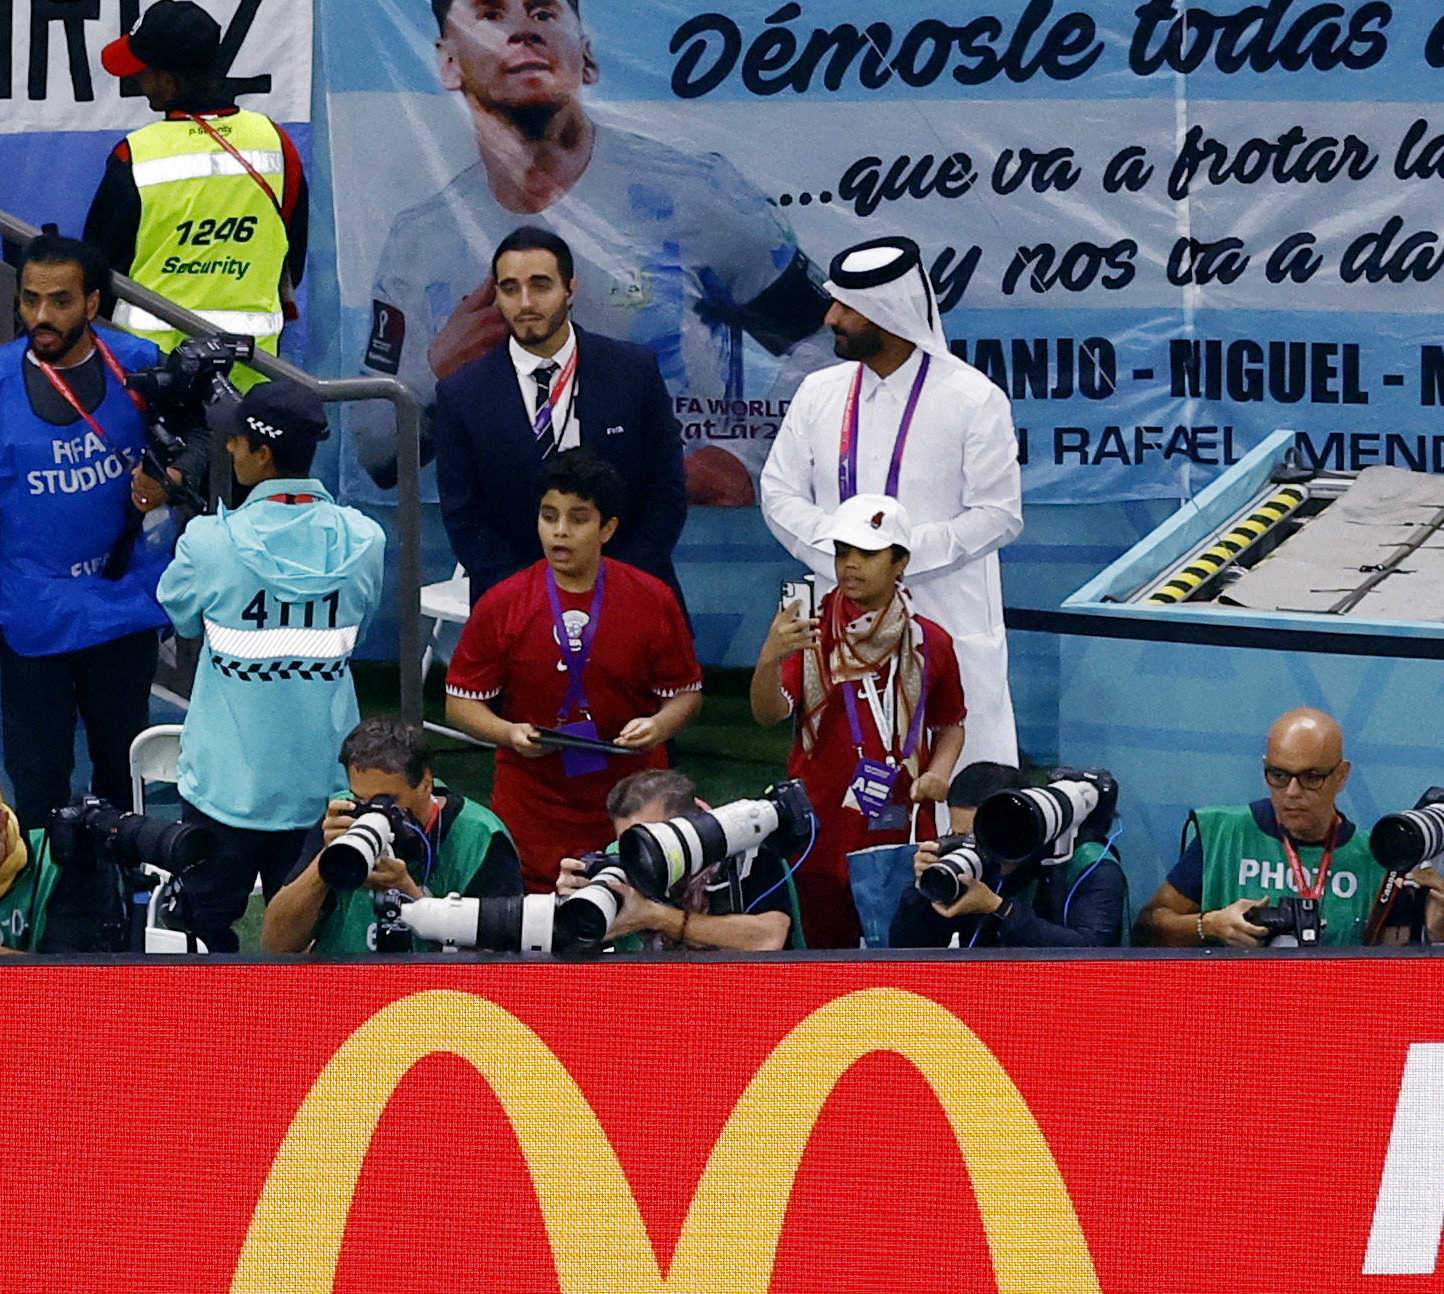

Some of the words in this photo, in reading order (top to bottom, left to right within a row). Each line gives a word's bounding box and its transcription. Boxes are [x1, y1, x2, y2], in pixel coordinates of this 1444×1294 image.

[668, 2, 1104, 98] Démosle
[1128, 0, 1391, 76] todas
[990, 146, 1081, 195] va
[1102, 144, 1155, 194] a
[1168, 125, 1379, 200] frotar
[175, 214, 257, 246] 1246
[163, 258, 251, 280] Security
[1002, 237, 1138, 295] nos
[1166, 236, 1252, 287] va
[1264, 231, 1323, 284] a
[948, 336, 1117, 401] ANJO
[1170, 339, 1369, 404] NIGUEL
[51, 431, 106, 465] FIFA
